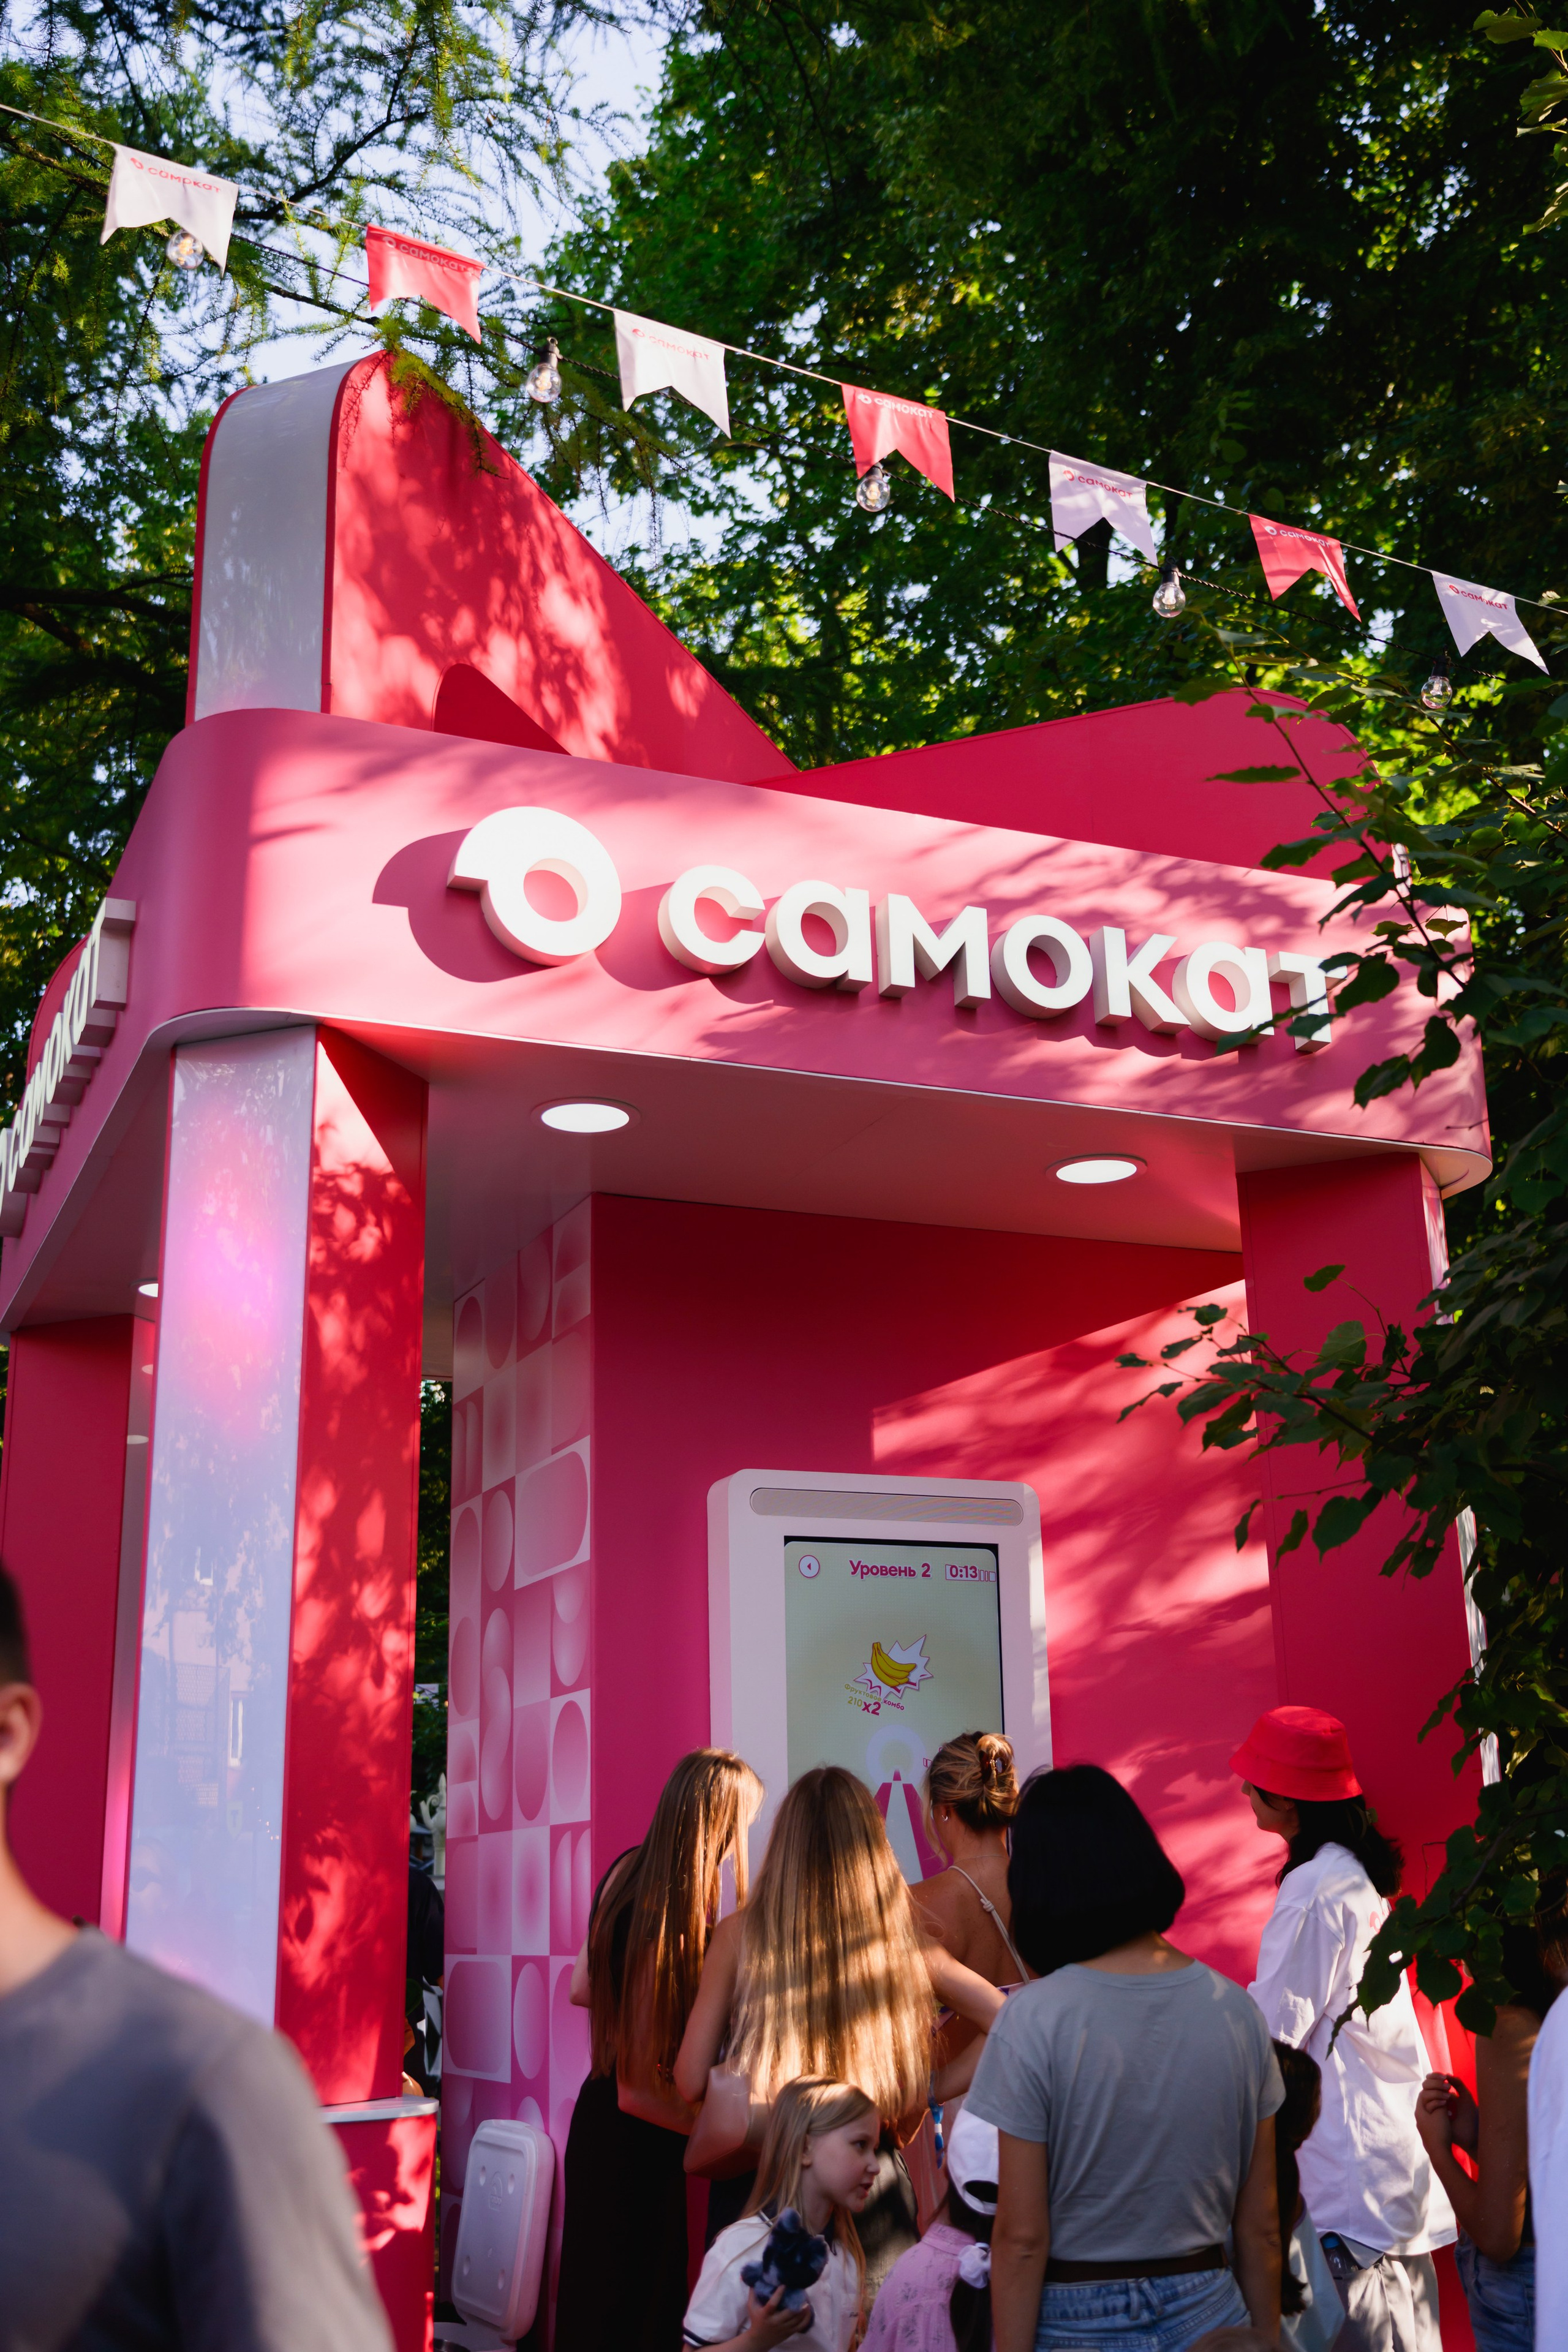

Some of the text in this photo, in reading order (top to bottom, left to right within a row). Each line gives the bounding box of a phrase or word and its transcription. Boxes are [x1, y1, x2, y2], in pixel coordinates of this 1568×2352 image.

[148, 167, 221, 193] самокат
[399, 243, 466, 271] самокат
[649, 336, 710, 360] самокат
[874, 398, 934, 418] самокат
[1077, 476, 1133, 499] самокат
[1280, 529, 1330, 548] самокат
[658, 864, 1348, 1052] самокат
[849, 1560, 931, 1579] Уровень 2
[949, 1565, 978, 1578] 0:13
[848, 1696, 862, 1707] 210
[883, 1698, 905, 1711] комбо
